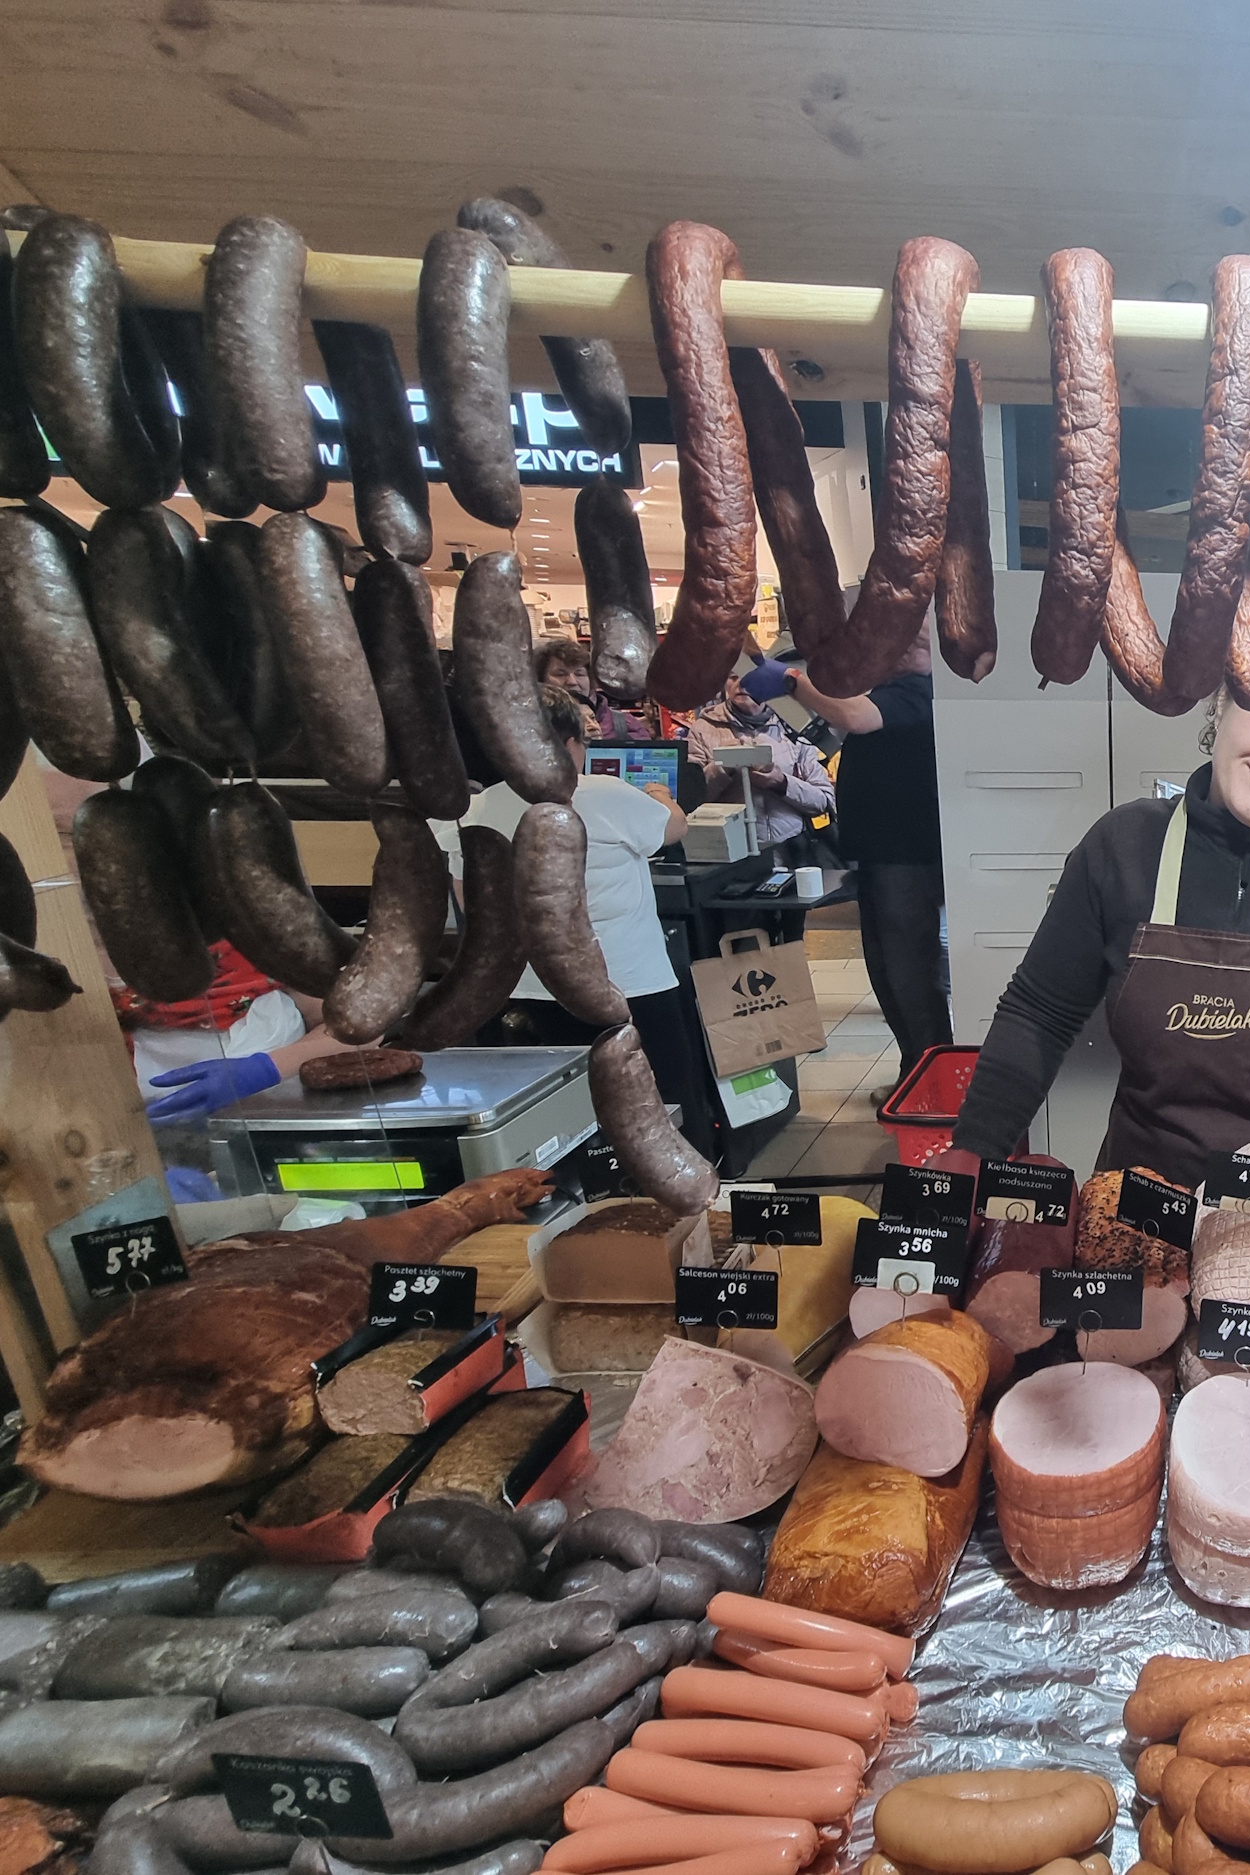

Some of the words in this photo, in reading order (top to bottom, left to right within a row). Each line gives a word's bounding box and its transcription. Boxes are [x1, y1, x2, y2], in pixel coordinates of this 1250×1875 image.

[1192, 994, 1235, 1008] BRACIA
[588, 1145, 614, 1157] Paszte
[1129, 1173, 1149, 1187] Schab
[878, 1222, 911, 1236] Szynka
[912, 1226, 949, 1239] mnicha
[384, 1265, 417, 1275] Pasztet
[419, 1267, 467, 1280] szlachetny
[679, 1268, 718, 1279] Salceson
[720, 1272, 751, 1282] wiejski
[1052, 1270, 1083, 1280] Szynka
[1085, 1271, 1132, 1280] szlachetna
[934, 1275, 960, 1287] /100g
